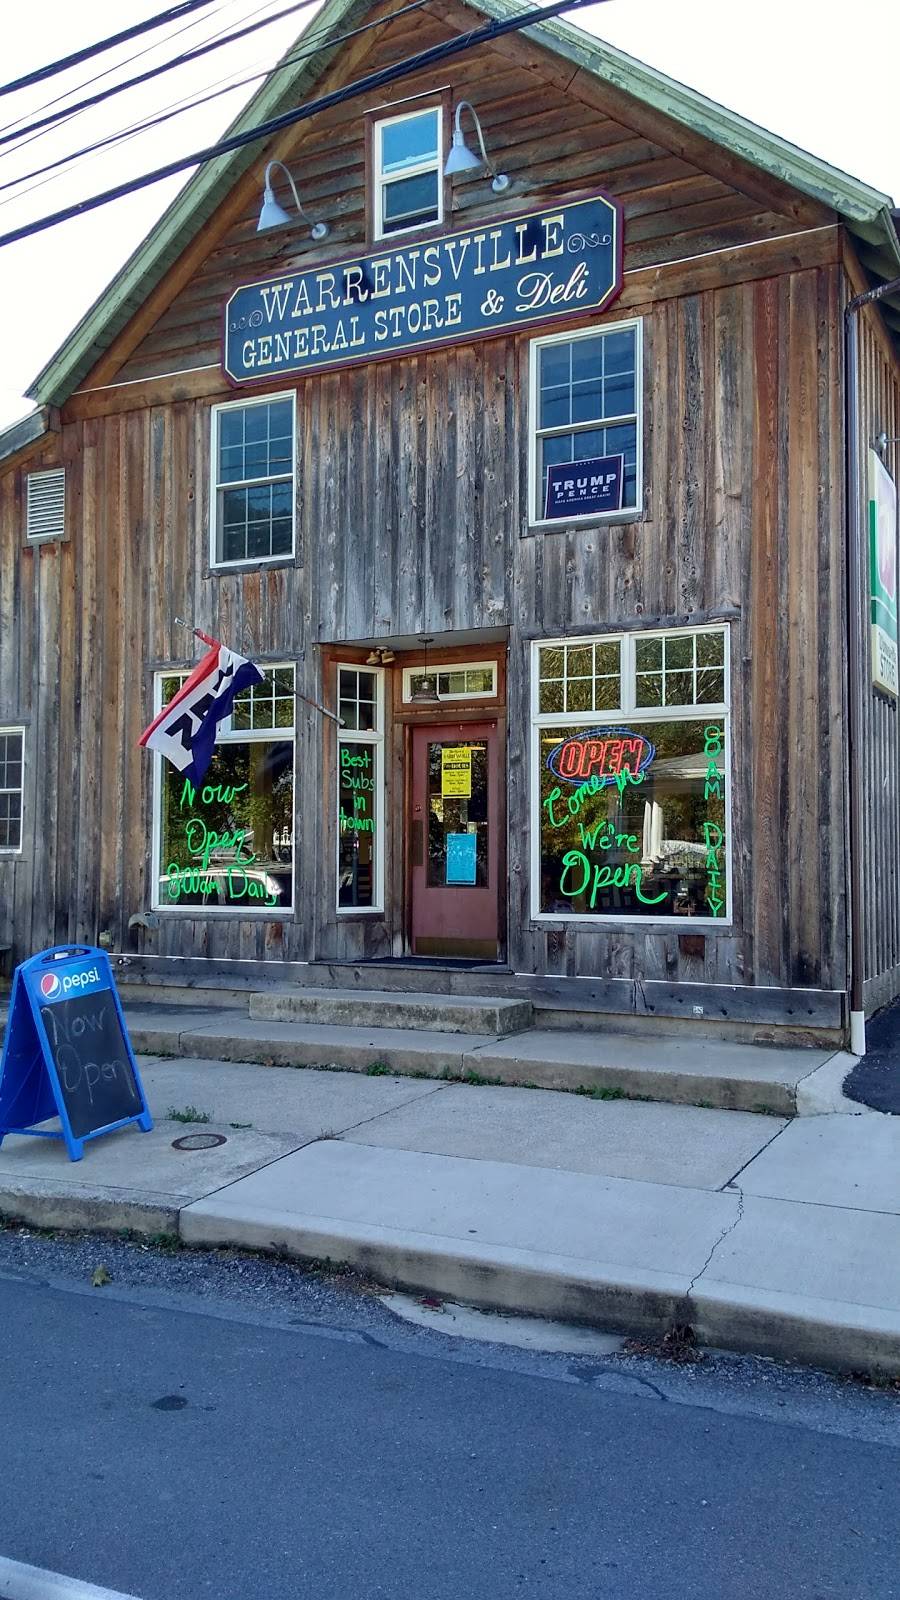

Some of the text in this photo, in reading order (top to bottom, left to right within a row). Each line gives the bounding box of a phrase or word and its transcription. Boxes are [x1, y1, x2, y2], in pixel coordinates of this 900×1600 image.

[260, 213, 565, 324] WARRENSVILLE
[242, 261, 591, 369] GENERAL STORE & Deli
[552, 473, 617, 492] TRUMP
[556, 485, 610, 499] PENCE
[341, 748, 371, 768] Best
[559, 739, 643, 777] OPEN
[180, 778, 249, 811] Now
[342, 769, 376, 791] Subs
[339, 806, 375, 833] town
[353, 791, 366, 811] in
[543, 775, 607, 827] Come
[185, 818, 256, 869] Open
[578, 821, 640, 853] We're
[226, 865, 278, 906] Daily
[559, 850, 669, 909] Open
[703, 822, 723, 918] DAILY
[62, 967, 101, 993] pepsi
[40, 1000, 107, 1046] Now
[56, 1044, 136, 1104] Open
